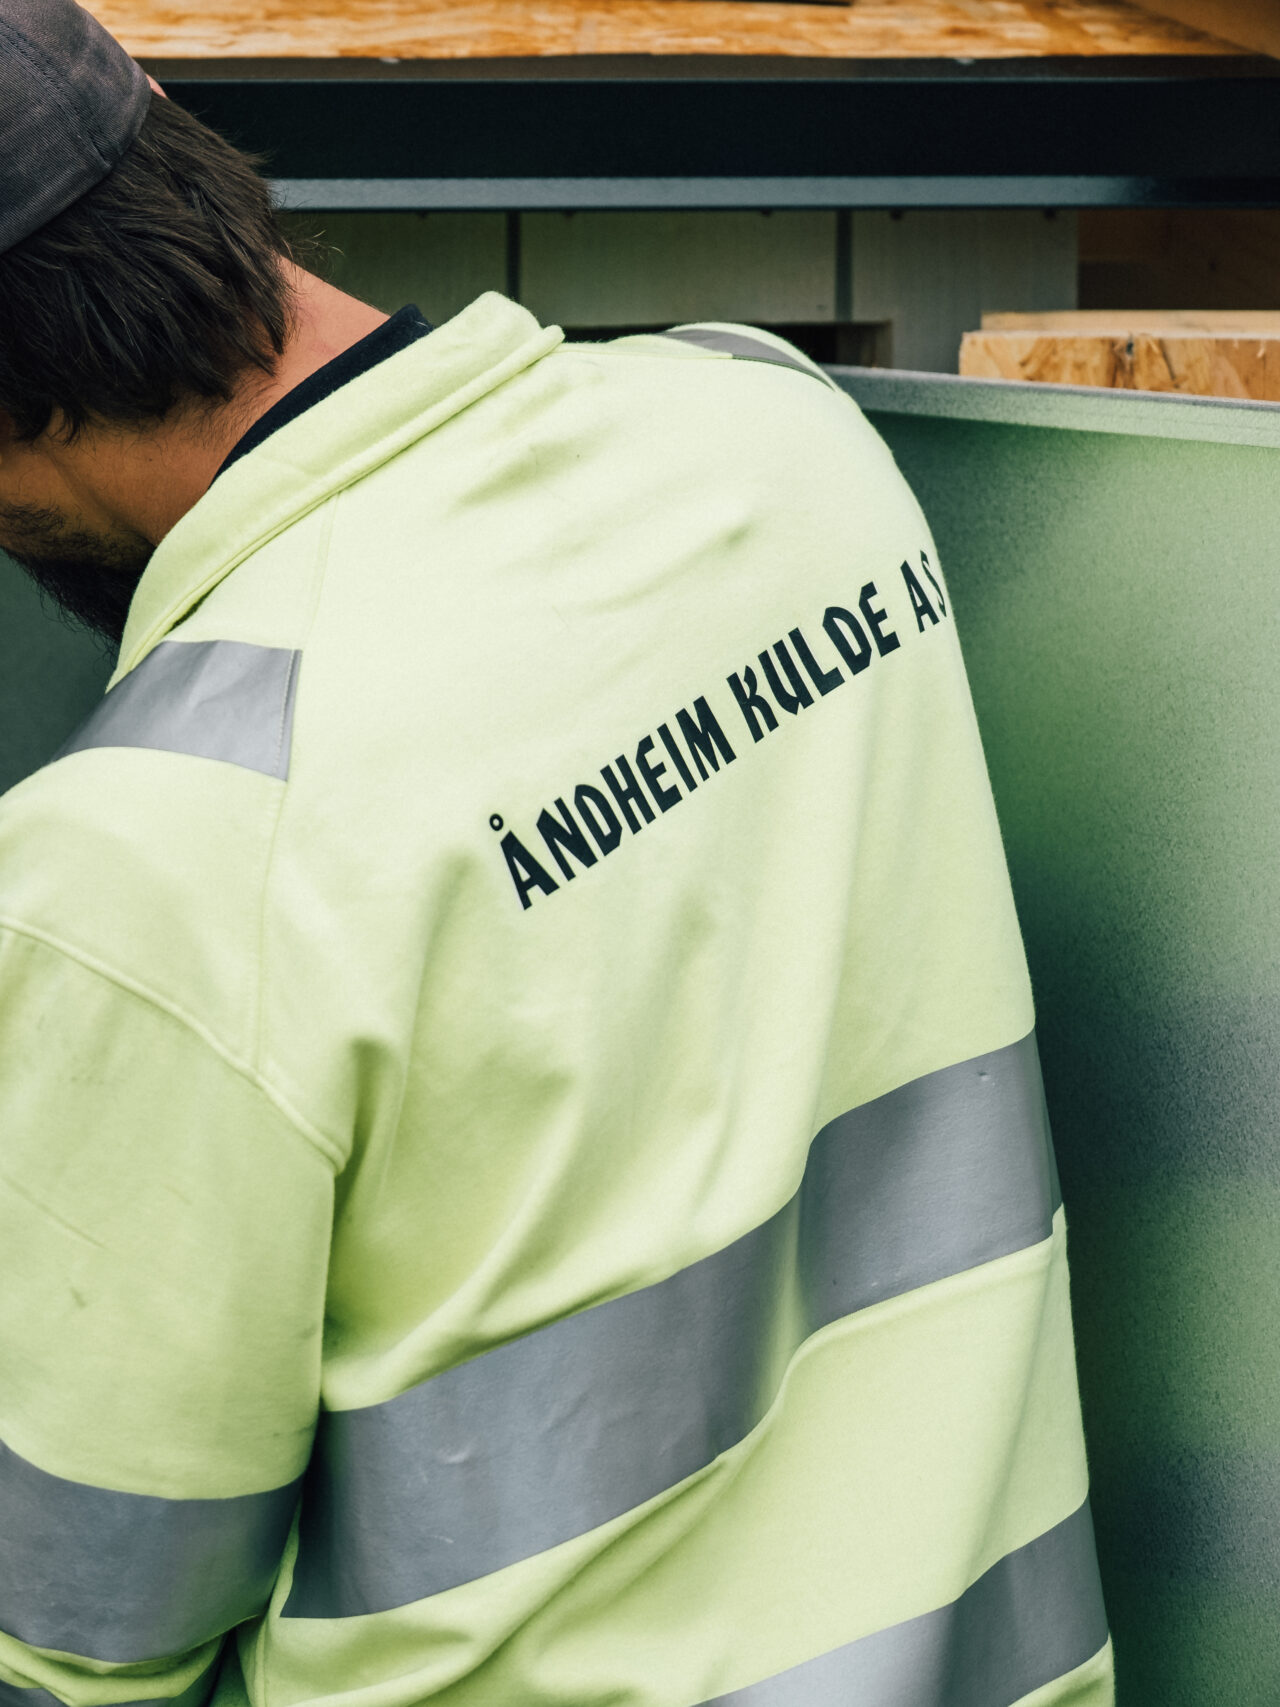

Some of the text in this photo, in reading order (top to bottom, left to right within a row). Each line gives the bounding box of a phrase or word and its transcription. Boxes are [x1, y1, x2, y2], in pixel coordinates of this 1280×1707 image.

[489, 549, 948, 911] ÅNDHEIM KULDE AS
